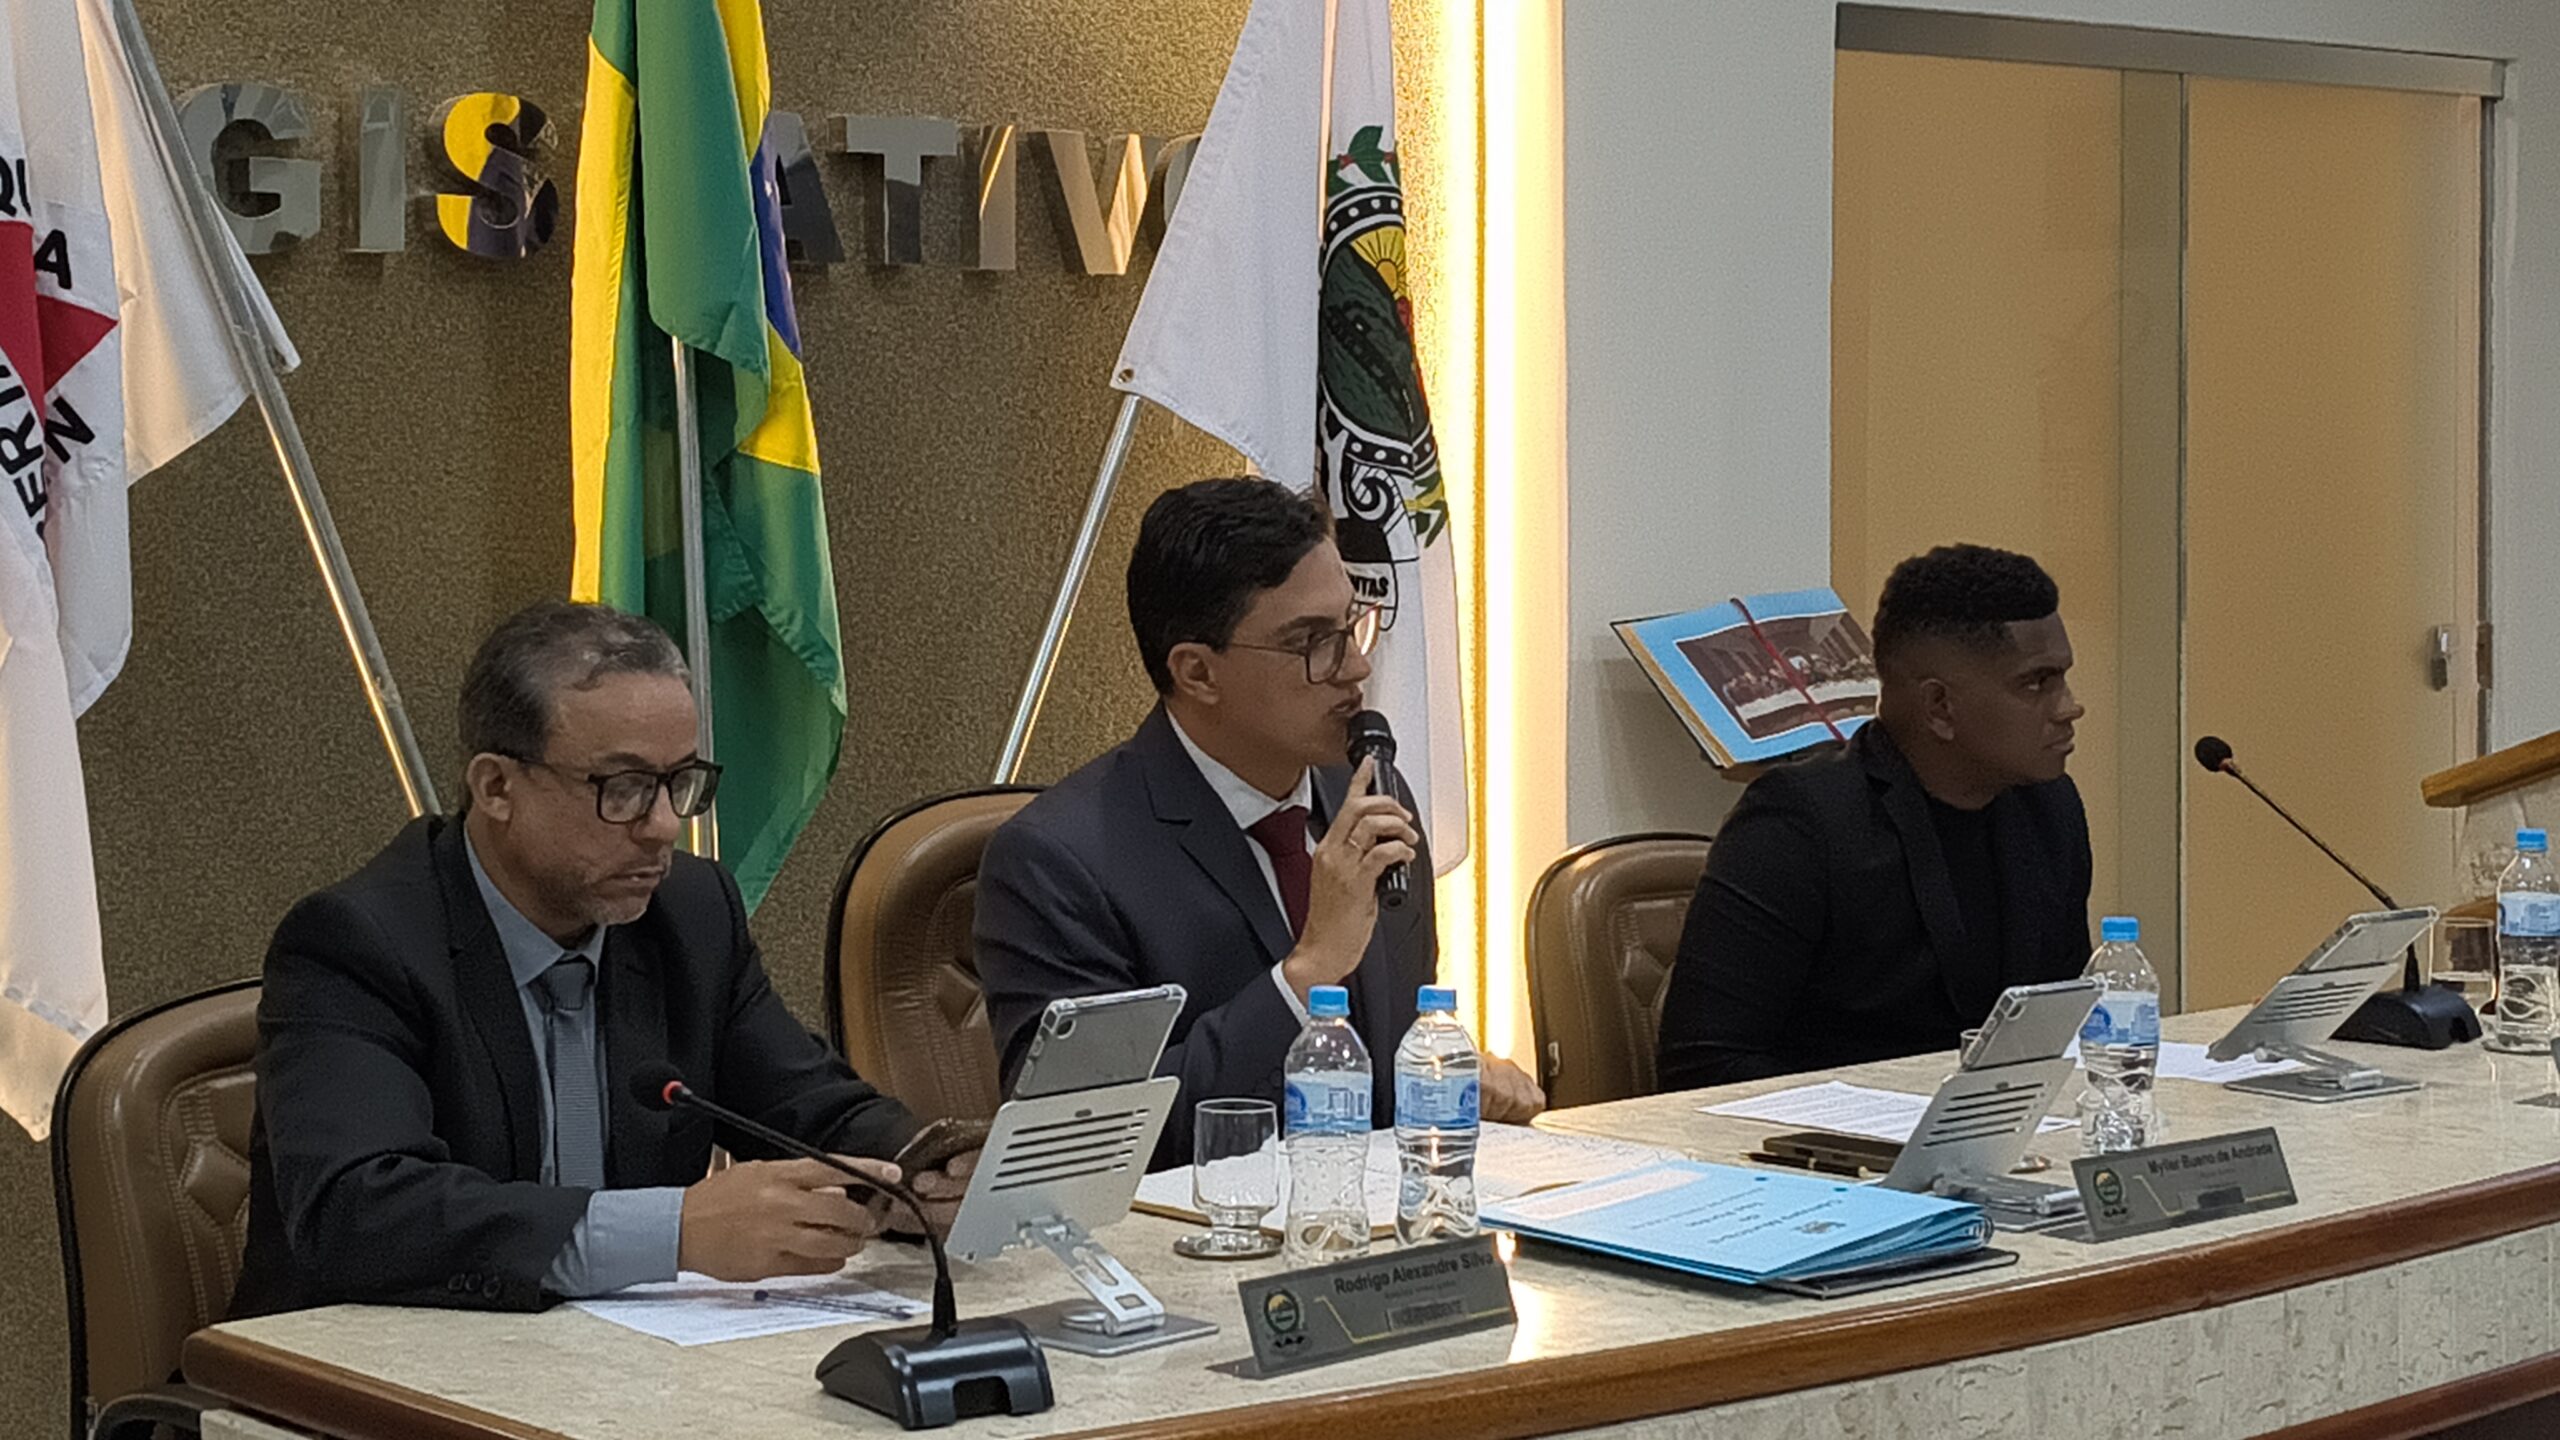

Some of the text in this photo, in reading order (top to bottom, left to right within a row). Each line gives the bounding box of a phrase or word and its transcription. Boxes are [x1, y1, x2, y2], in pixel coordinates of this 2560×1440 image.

[2181, 1153, 2215, 1169] Bueno
[2215, 1148, 2230, 1162] de
[2231, 1142, 2273, 1159] Andrade
[1334, 1272, 1390, 1295] Rodrigo
[1393, 1258, 1459, 1284] Alexandre
[1461, 1251, 1493, 1269] Silva
